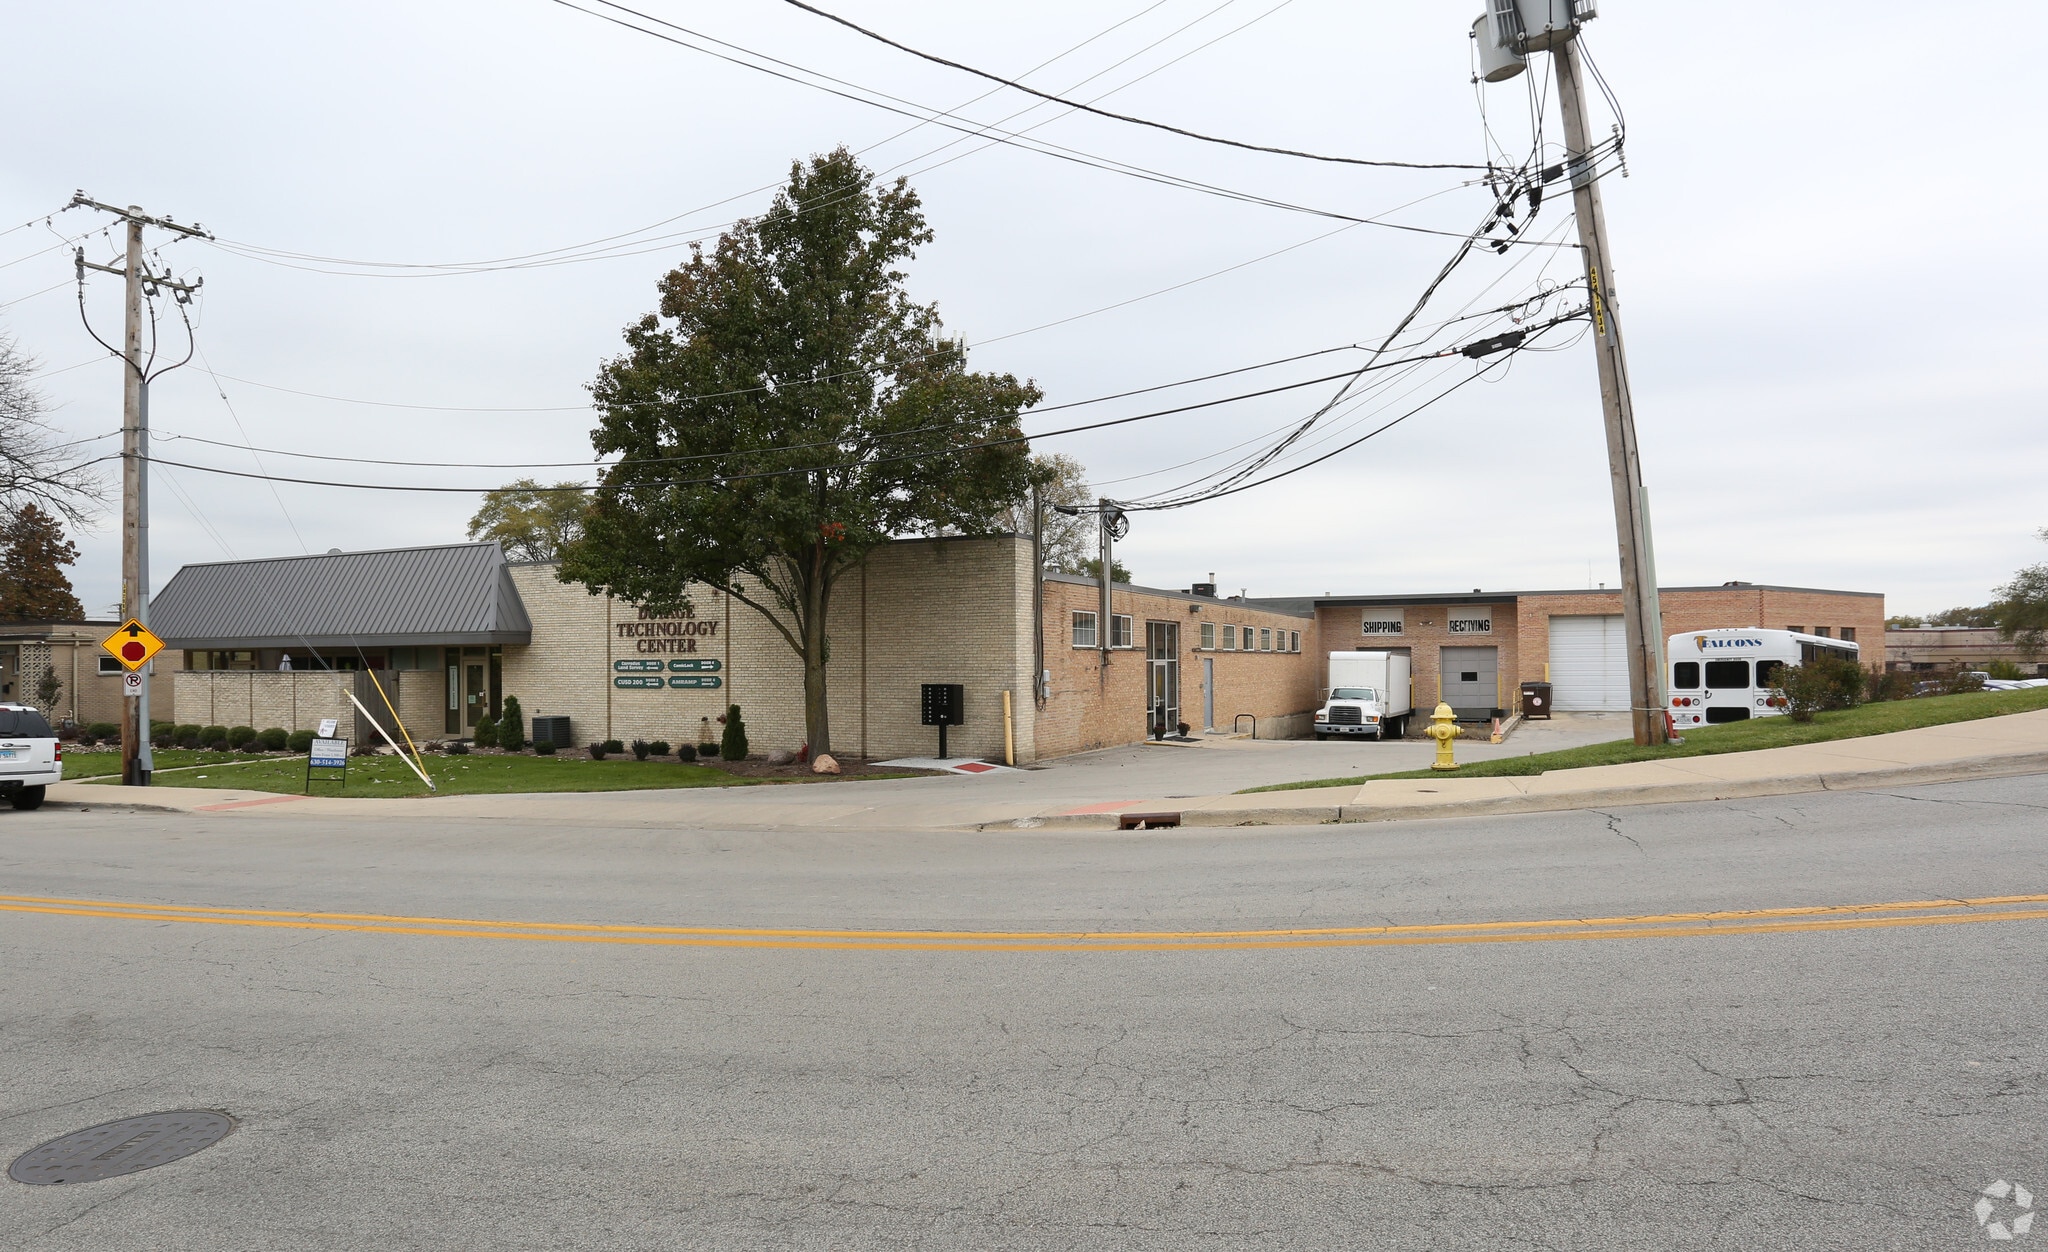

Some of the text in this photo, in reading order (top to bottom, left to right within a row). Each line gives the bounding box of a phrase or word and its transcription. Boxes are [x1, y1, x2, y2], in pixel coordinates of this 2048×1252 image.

[616, 621, 719, 637] TECHNOLOGY
[1363, 621, 1402, 634] SHIPPING
[636, 638, 697, 653] CENTER
[1702, 638, 1763, 648] FALCONS
